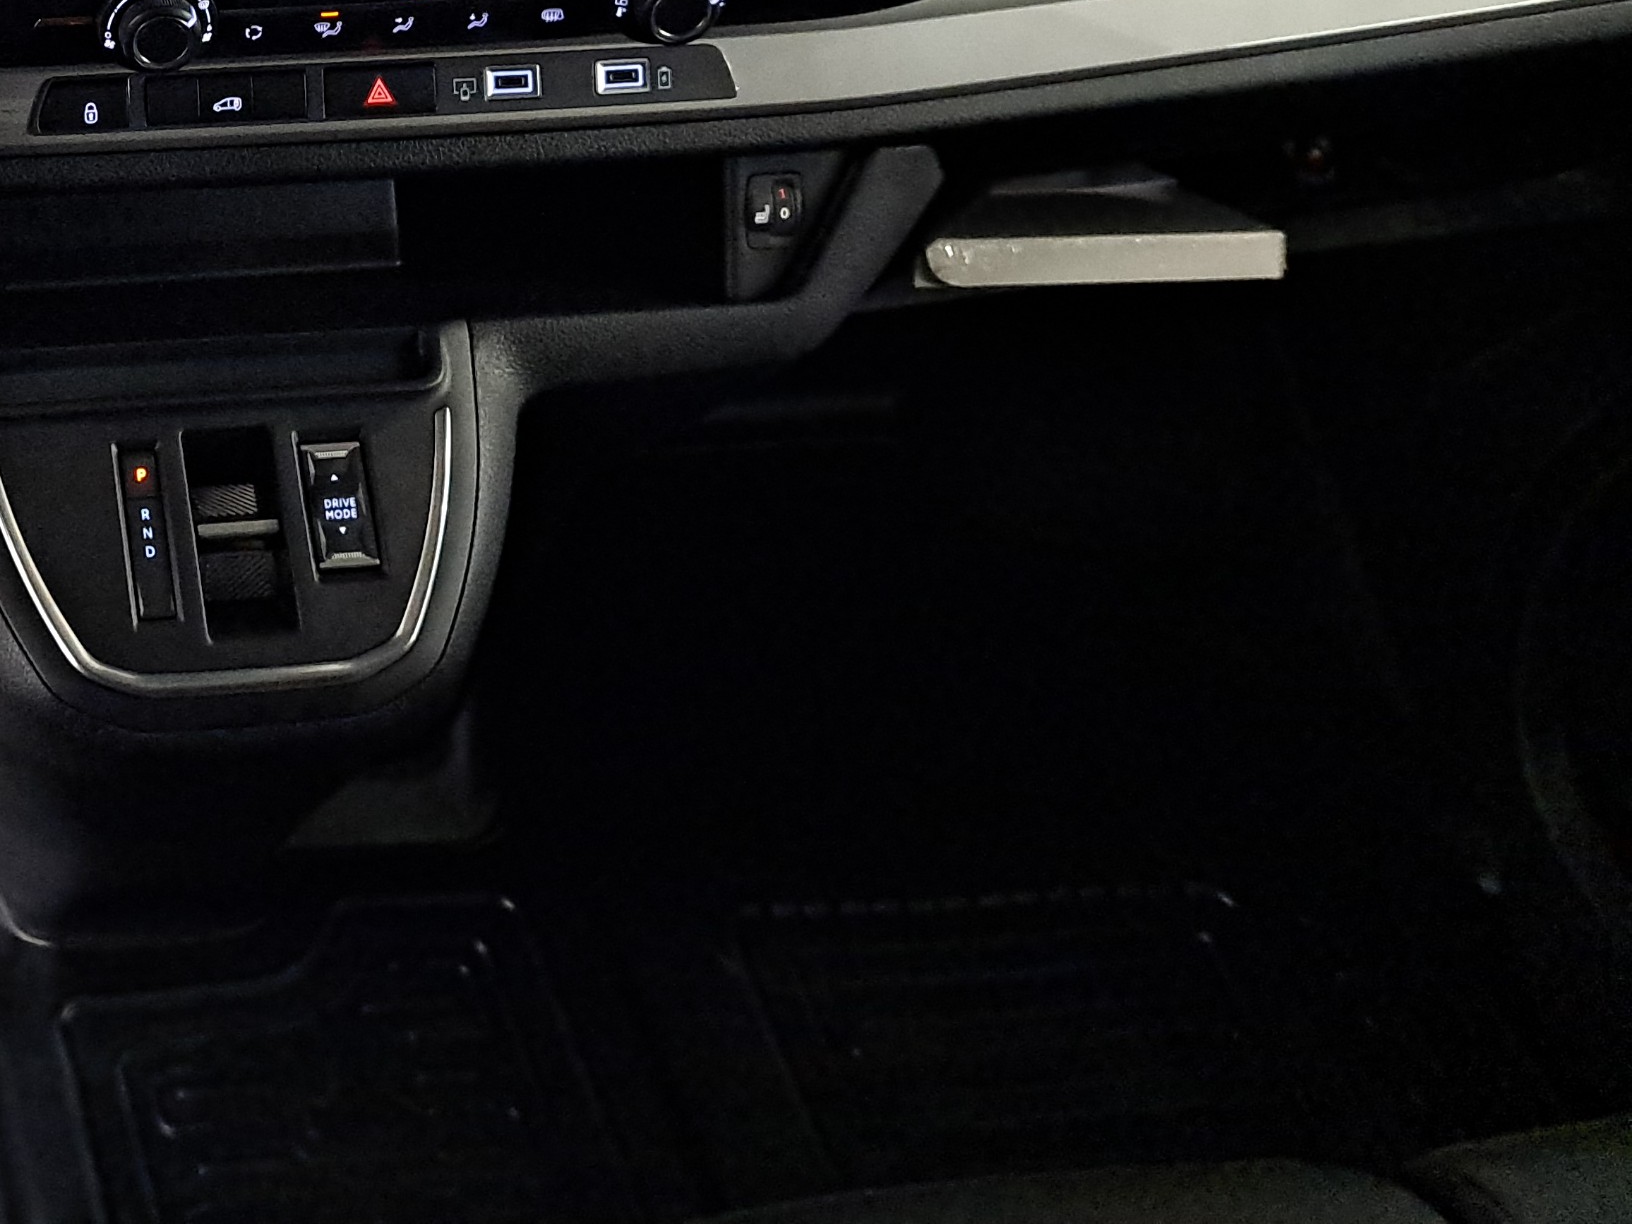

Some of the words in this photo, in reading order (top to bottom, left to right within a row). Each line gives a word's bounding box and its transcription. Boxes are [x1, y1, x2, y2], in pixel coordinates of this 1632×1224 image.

[780, 207, 790, 220] 0
[136, 467, 148, 482] P
[323, 497, 356, 509] DRIVE
[141, 508, 150, 521] R
[325, 508, 358, 520] MODE
[143, 527, 153, 540] N
[145, 545, 156, 559] D
